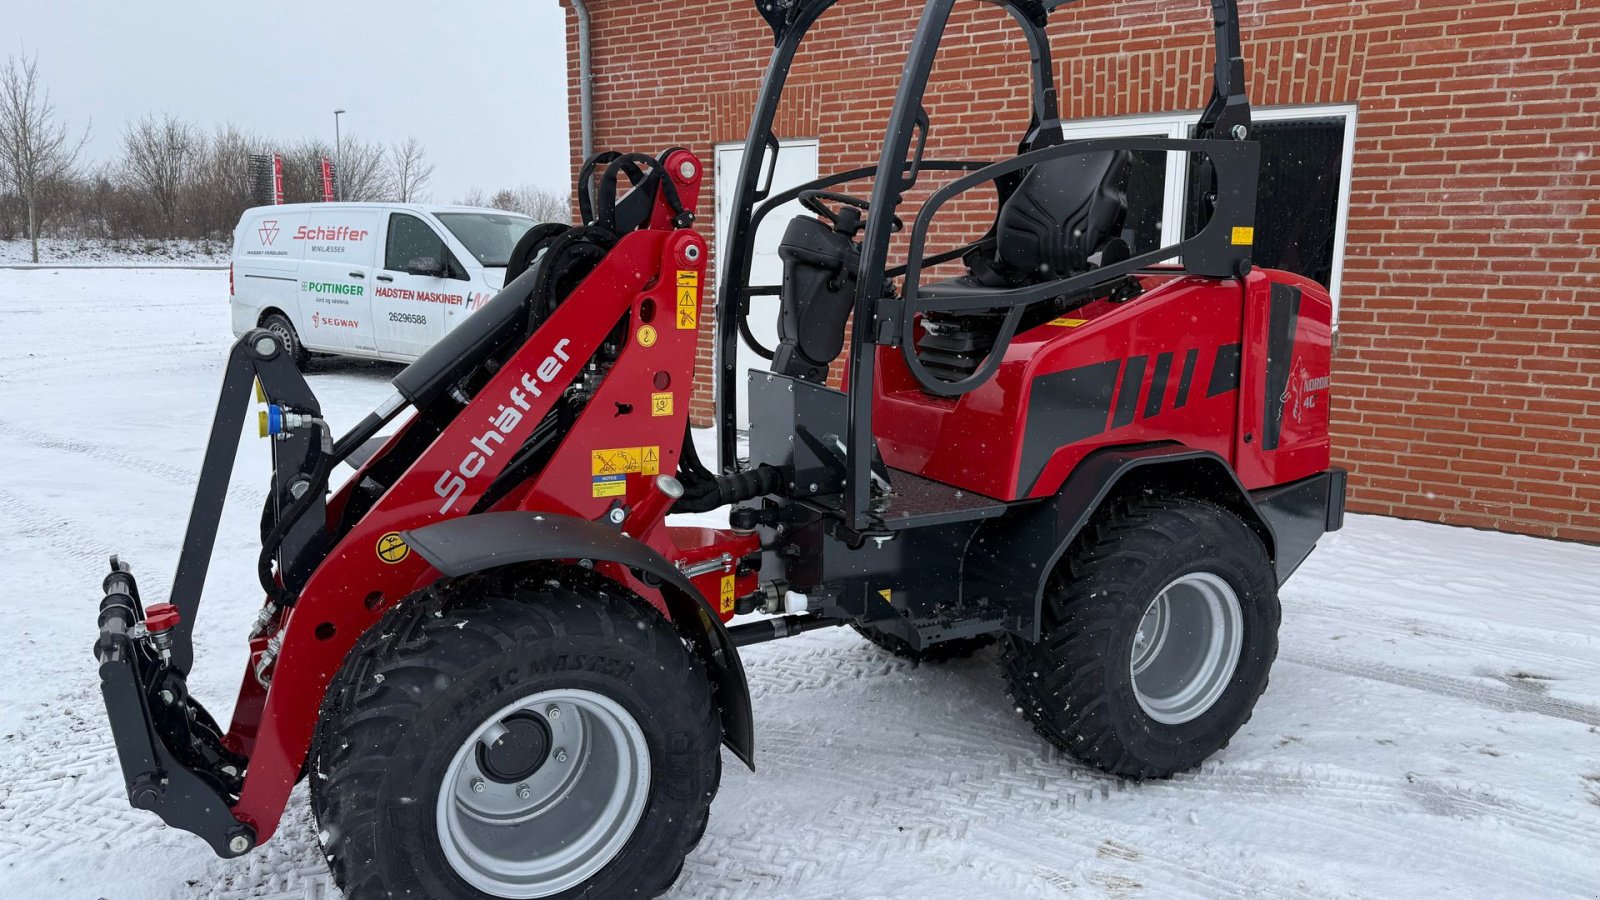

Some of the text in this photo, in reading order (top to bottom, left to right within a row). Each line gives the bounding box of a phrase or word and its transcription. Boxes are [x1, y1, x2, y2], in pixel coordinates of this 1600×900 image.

[293, 225, 368, 241] Schäffer
[375, 287, 463, 305] HADSTEN MASKINER
[321, 317, 359, 328] SEGWAY
[388, 312, 427, 325] 26296588
[1304, 375, 1330, 393] NORDIC
[434, 338, 570, 515] Schäffer
